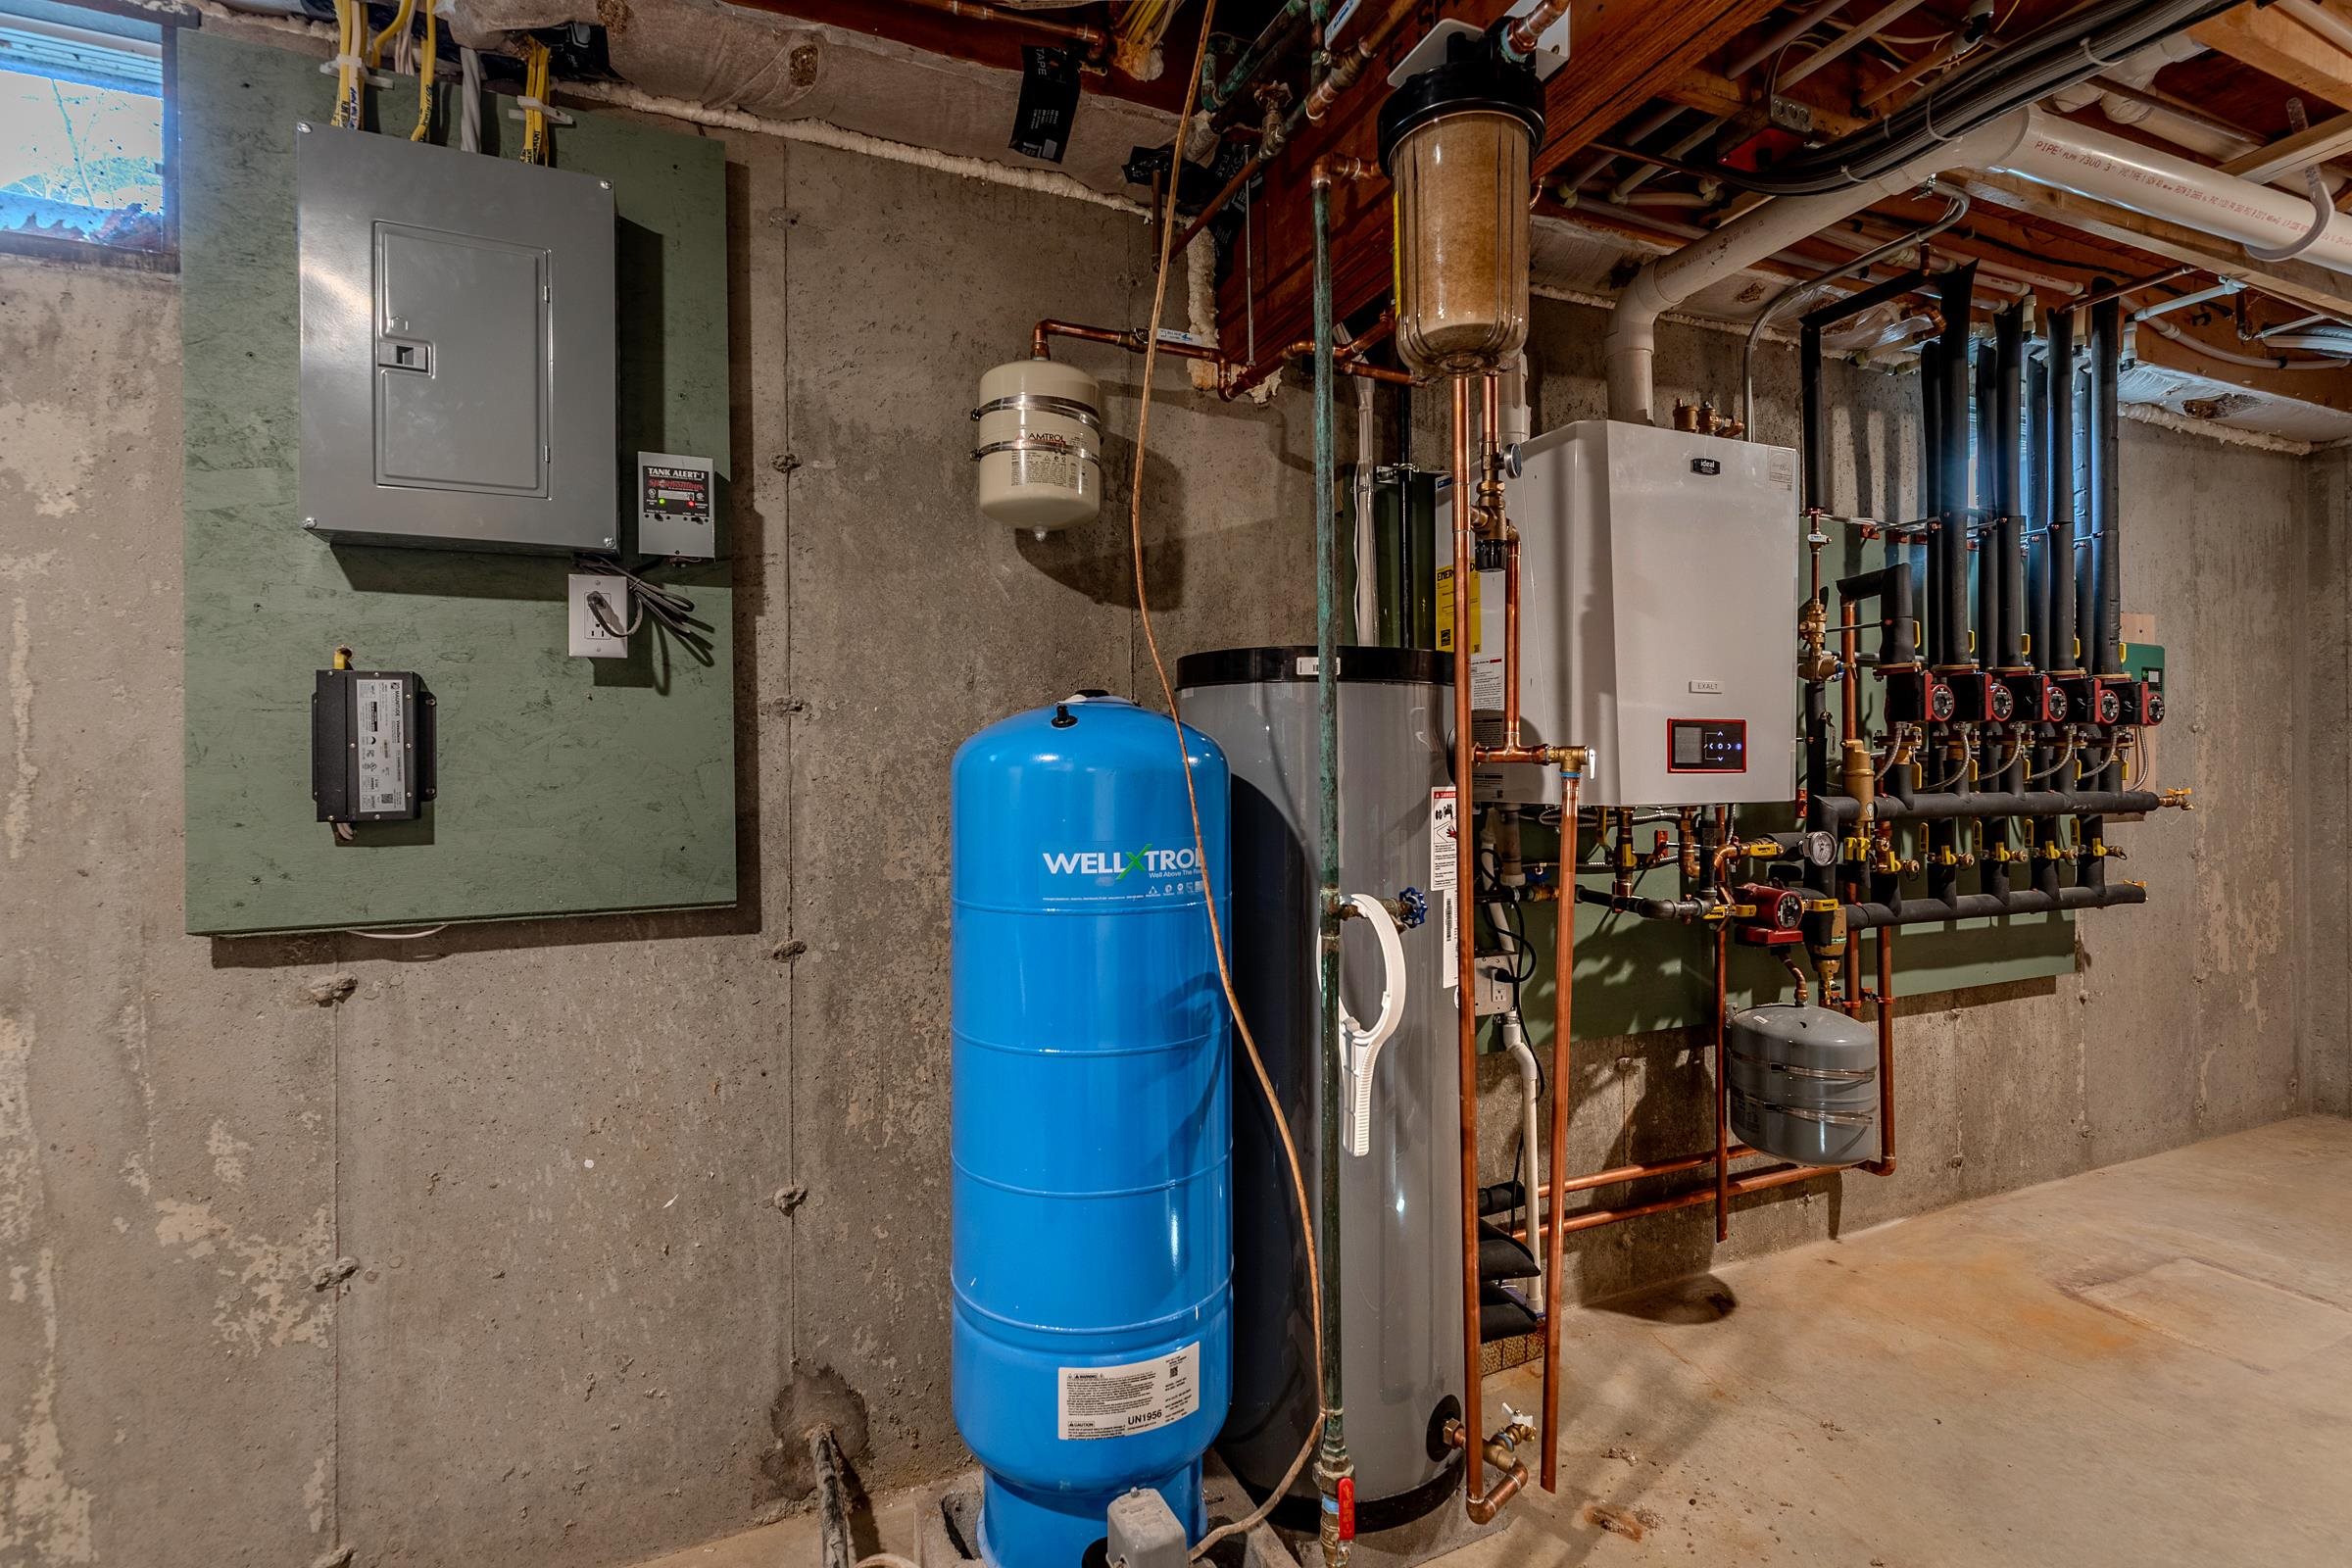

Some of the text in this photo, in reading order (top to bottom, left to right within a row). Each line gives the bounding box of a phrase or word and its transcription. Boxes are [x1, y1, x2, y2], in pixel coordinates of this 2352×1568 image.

[1036, 48, 1047, 75] TAPE
[1028, 432, 1065, 443] AMTROL
[1700, 460, 1715, 468] ideal
[648, 467, 670, 476] TANK
[1127, 1409, 1162, 1426] UN1956
